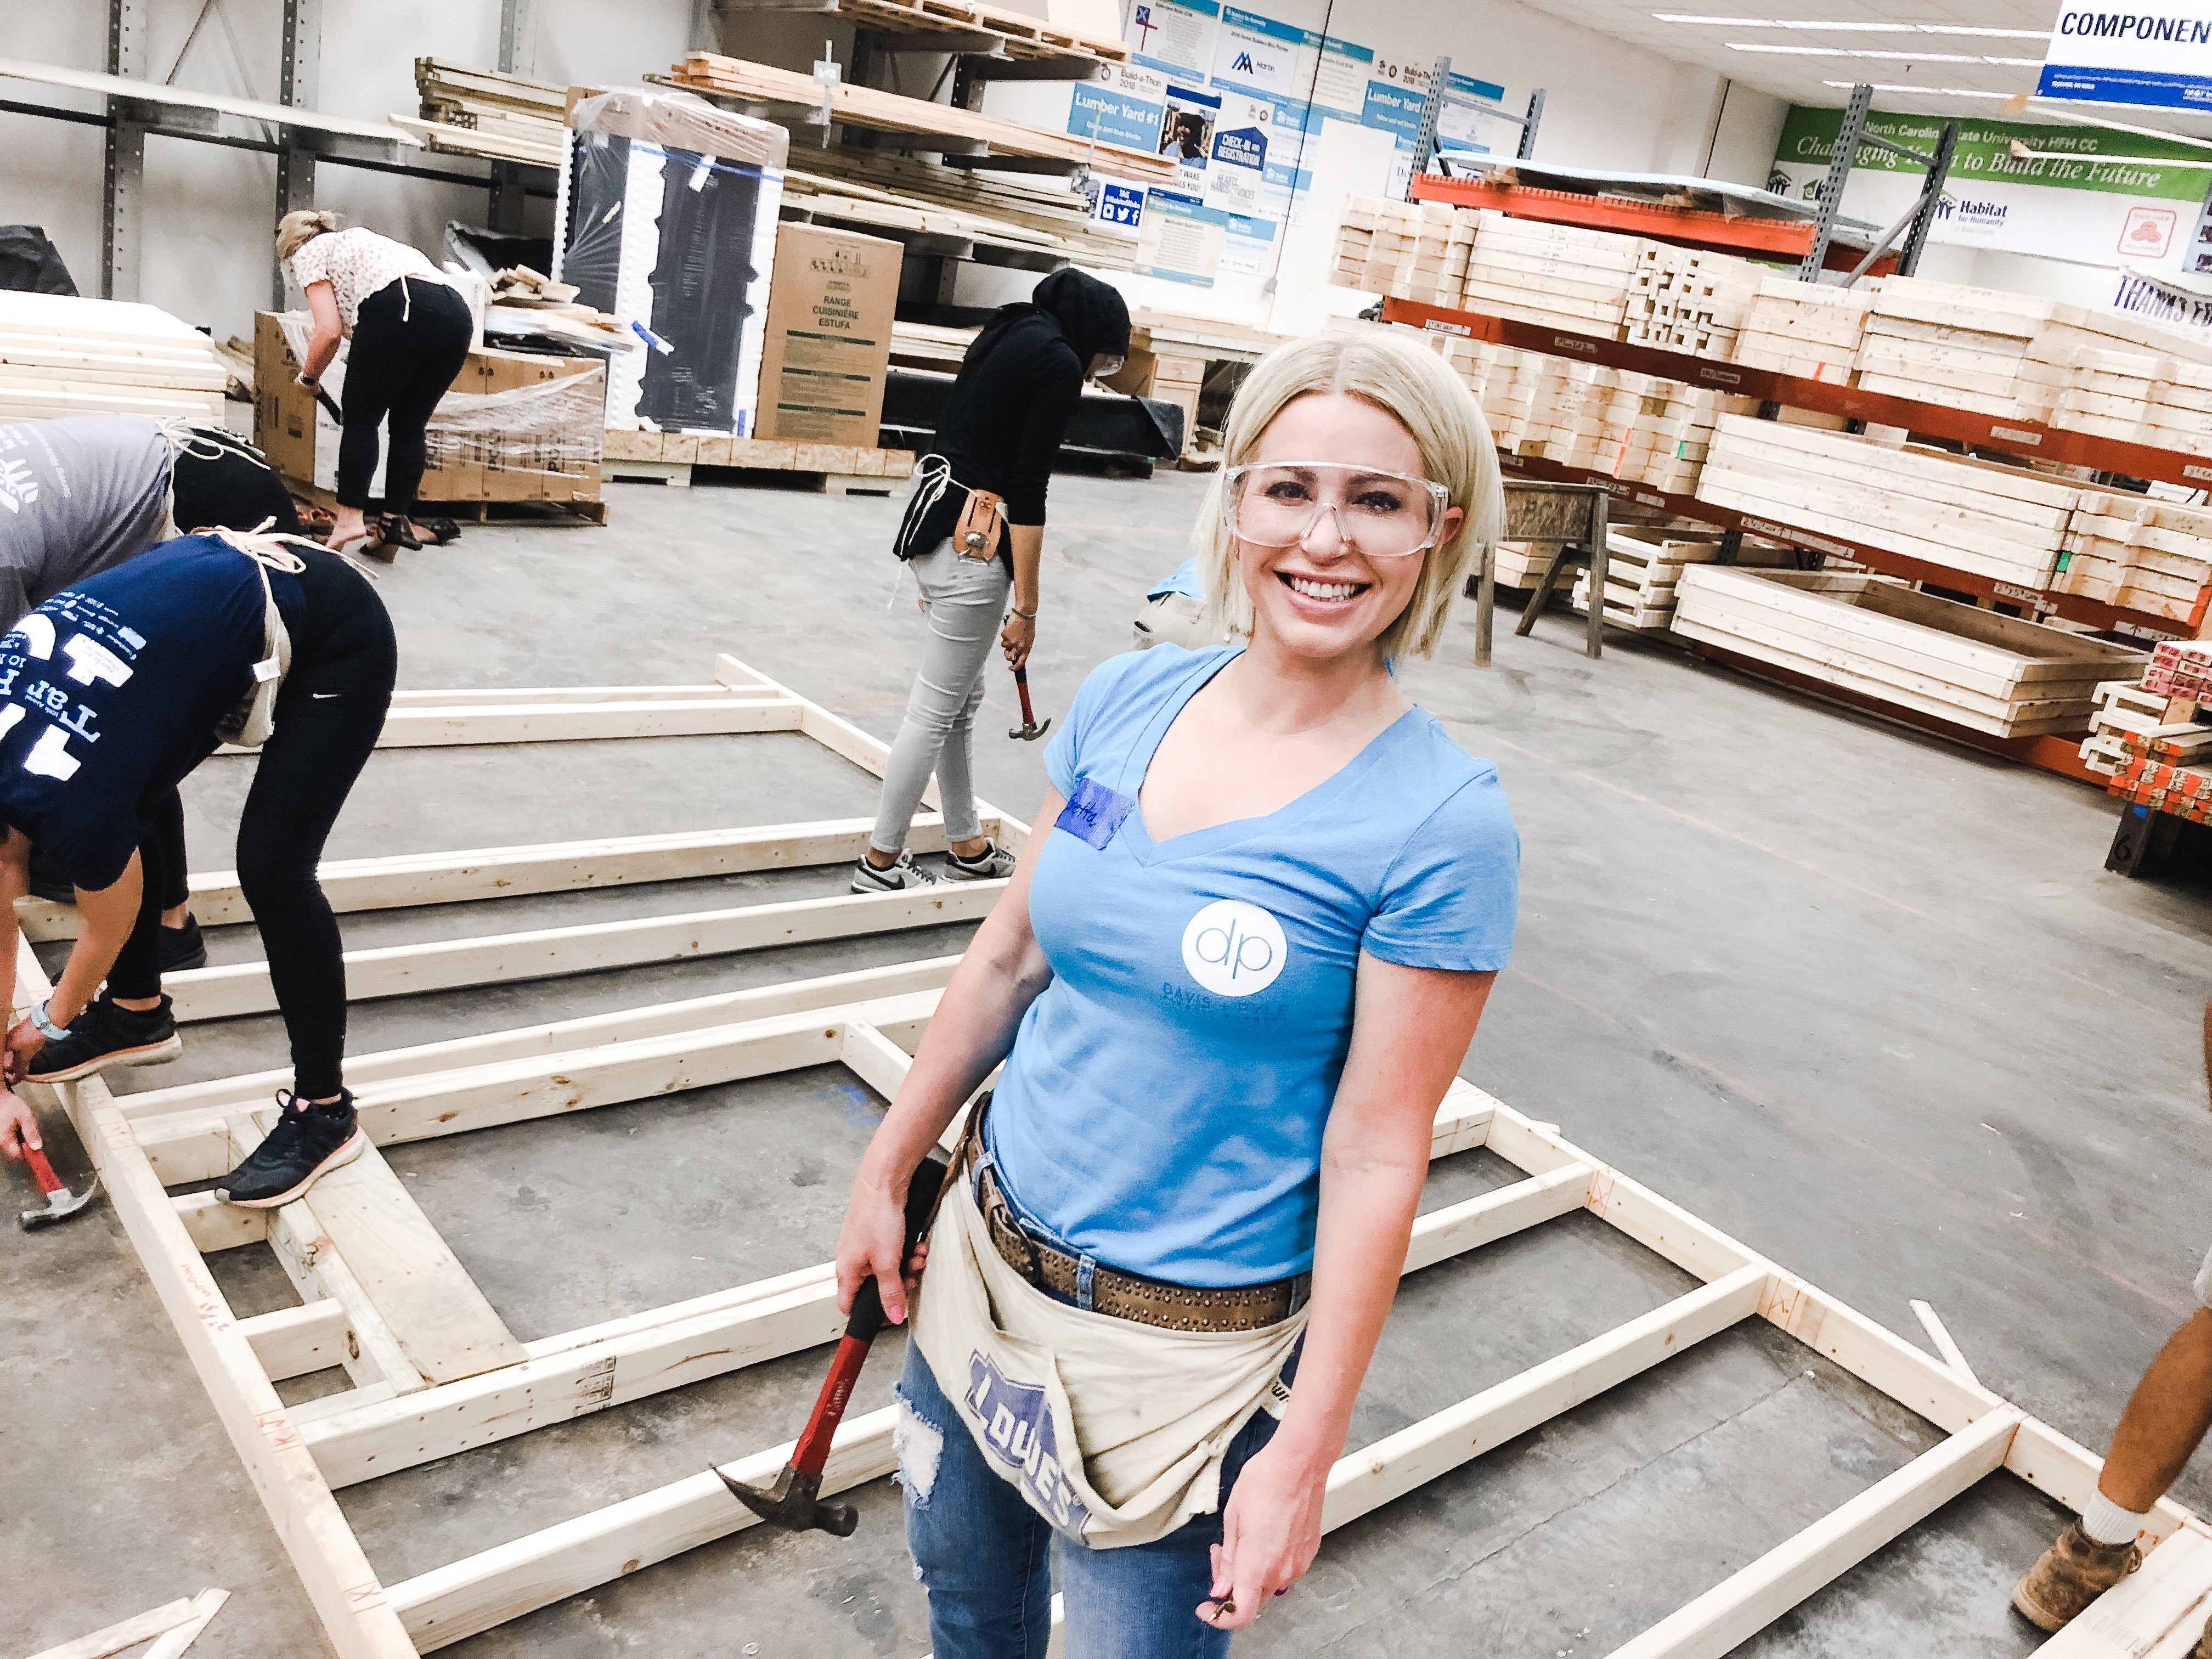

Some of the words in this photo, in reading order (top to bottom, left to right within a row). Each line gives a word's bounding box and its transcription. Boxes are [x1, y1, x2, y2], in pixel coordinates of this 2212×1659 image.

[2061, 12, 2212, 44] COMPONEN
[1075, 91, 1120, 115] Lumber
[1121, 103, 1146, 123] Yard
[1368, 87, 1402, 108] Lumber
[1403, 97, 1422, 114] Yard
[1866, 121, 1896, 135] North
[1898, 123, 1940, 140] Carolin
[1963, 151, 1984, 171] to
[1987, 151, 2047, 177] Build
[2049, 157, 2084, 180] the
[2085, 161, 2162, 189] Future
[1960, 200, 2008, 217] Habitat
[1970, 216, 2004, 228] Humanity
[824, 295, 852, 307] RANGE
[2114, 274, 2188, 323] THANKS
[818, 318, 851, 330] ESTUFA
[26, 679, 101, 743] Tar
[1196, 917, 1273, 980] dp
